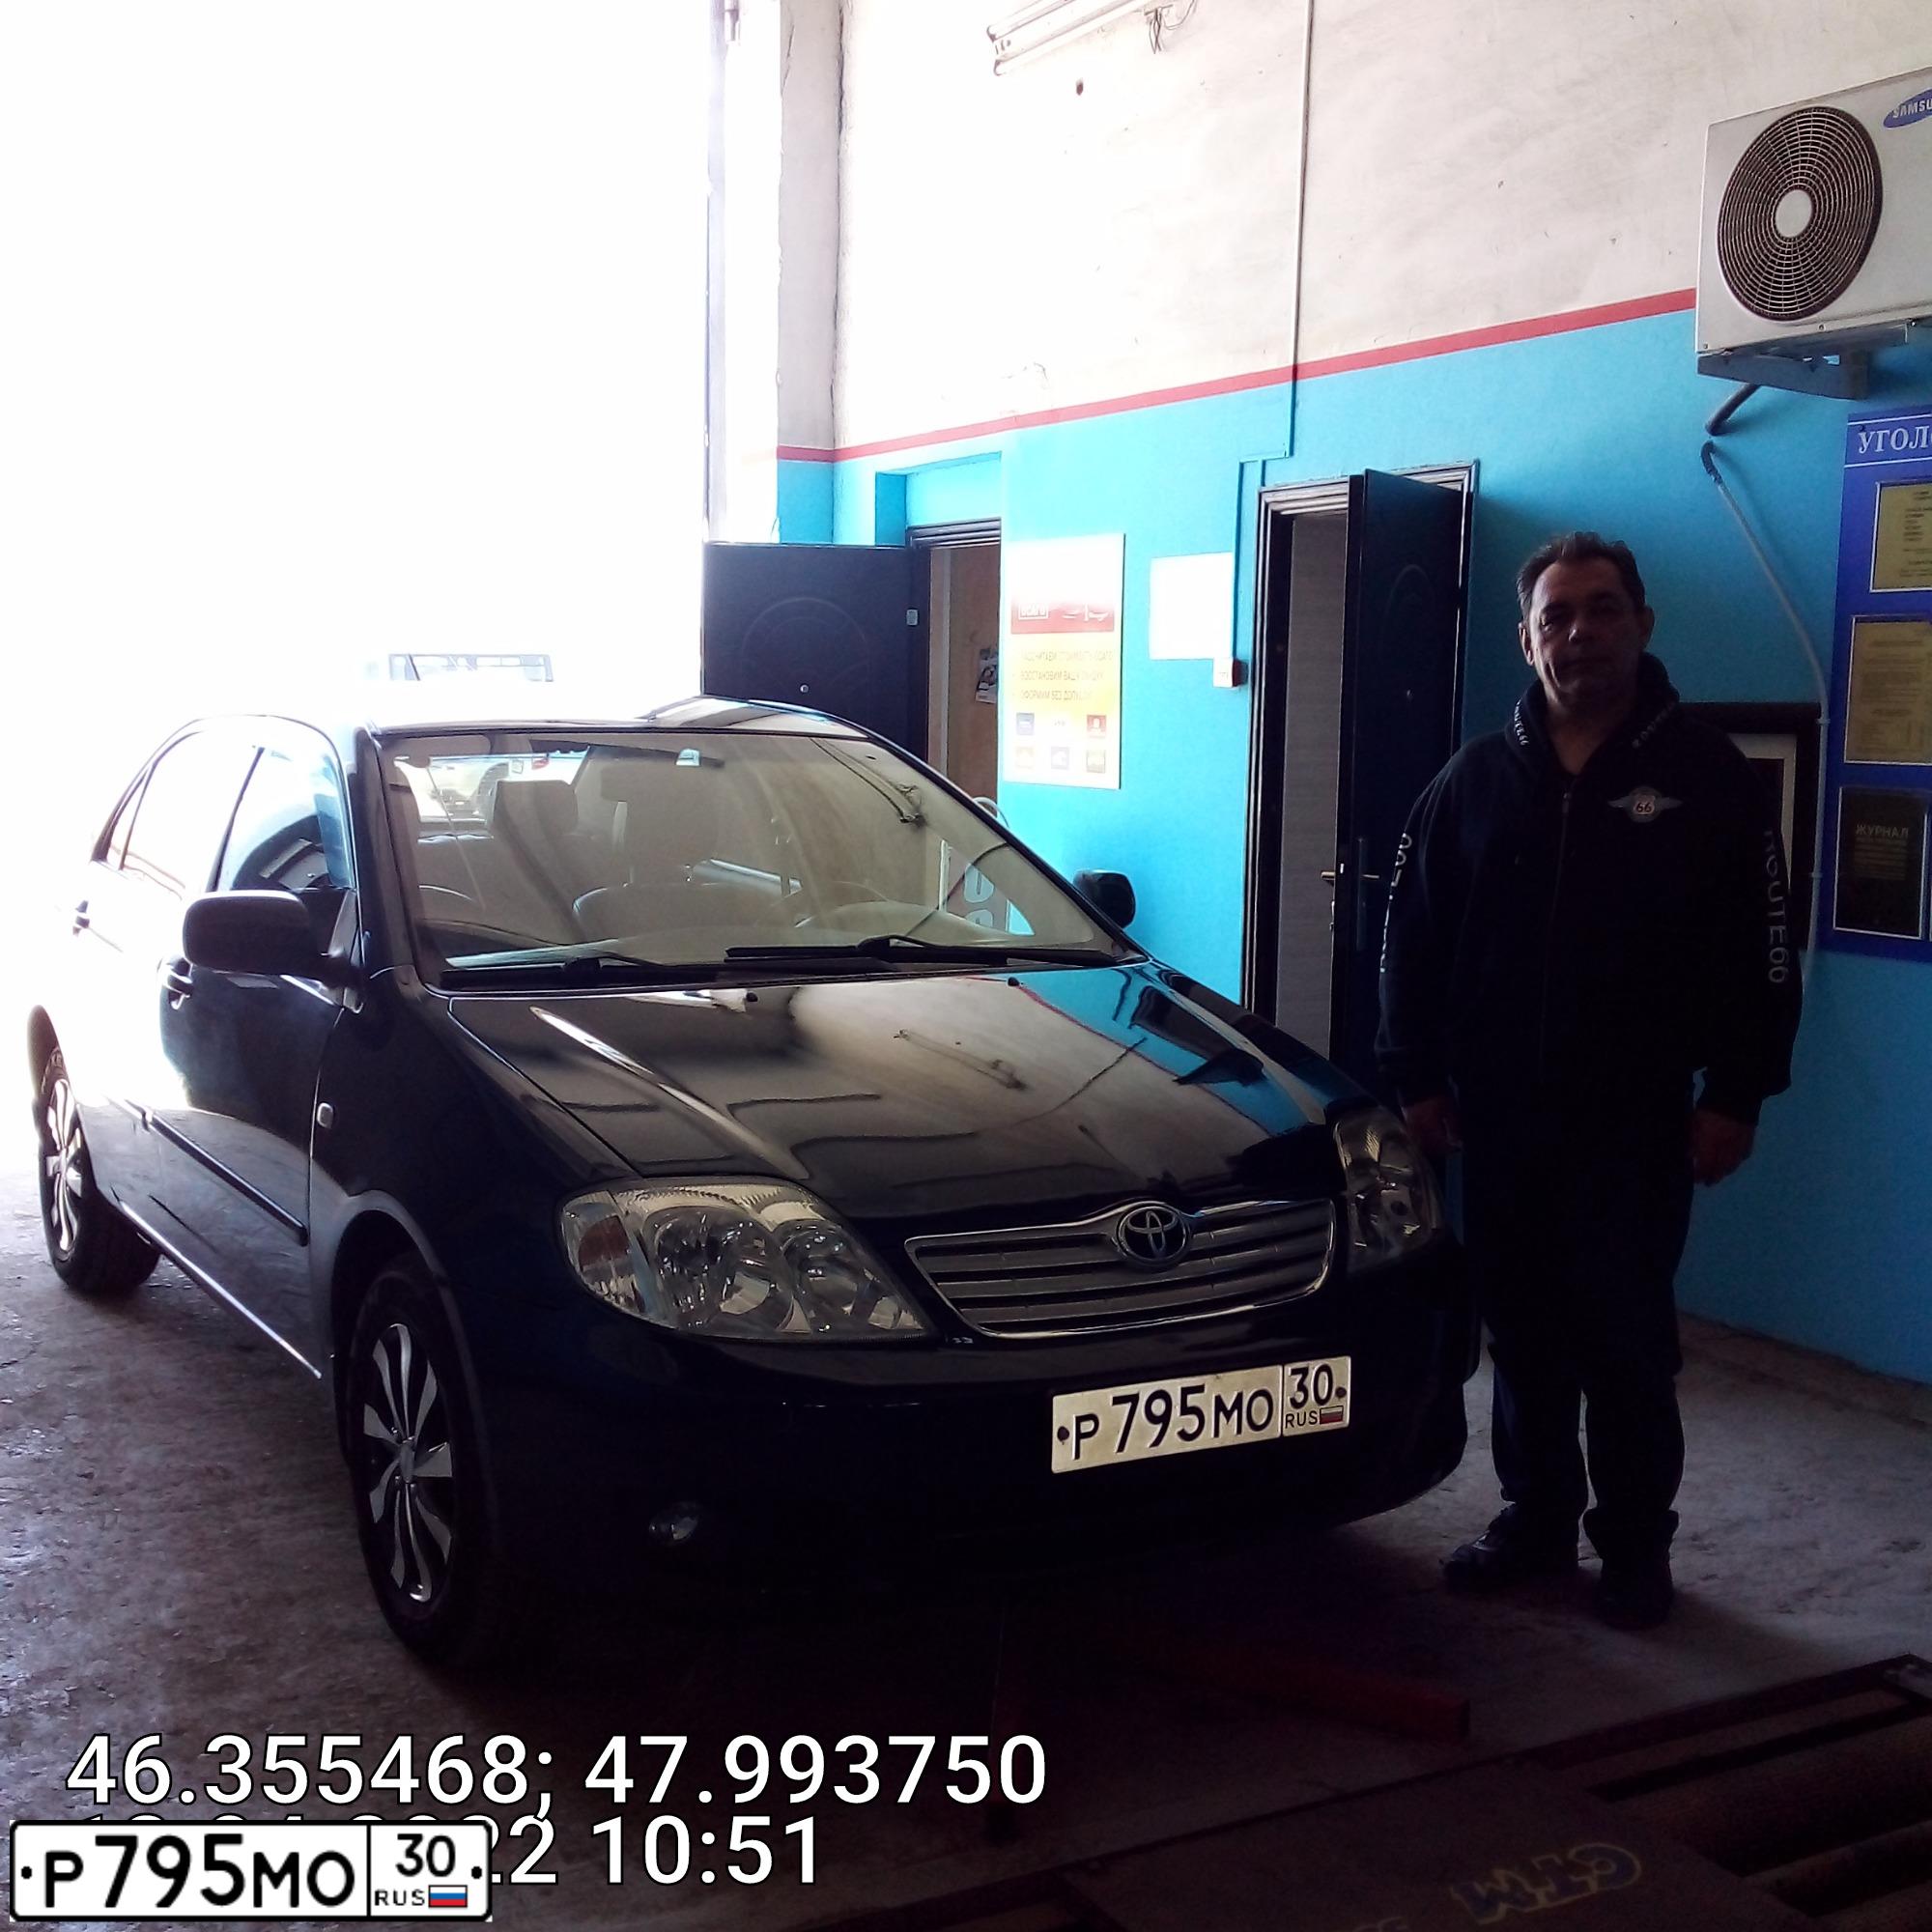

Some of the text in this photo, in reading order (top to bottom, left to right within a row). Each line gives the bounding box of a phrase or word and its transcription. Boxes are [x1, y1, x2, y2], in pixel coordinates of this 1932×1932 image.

[1859, 425, 1932, 454] УГОЛ
[1636, 802, 1652, 812] 66
[1855, 824, 1909, 839] ЖУРНАЛ
[1288, 1363, 1334, 1409] 30
[1284, 1409, 1319, 1429] RUS
